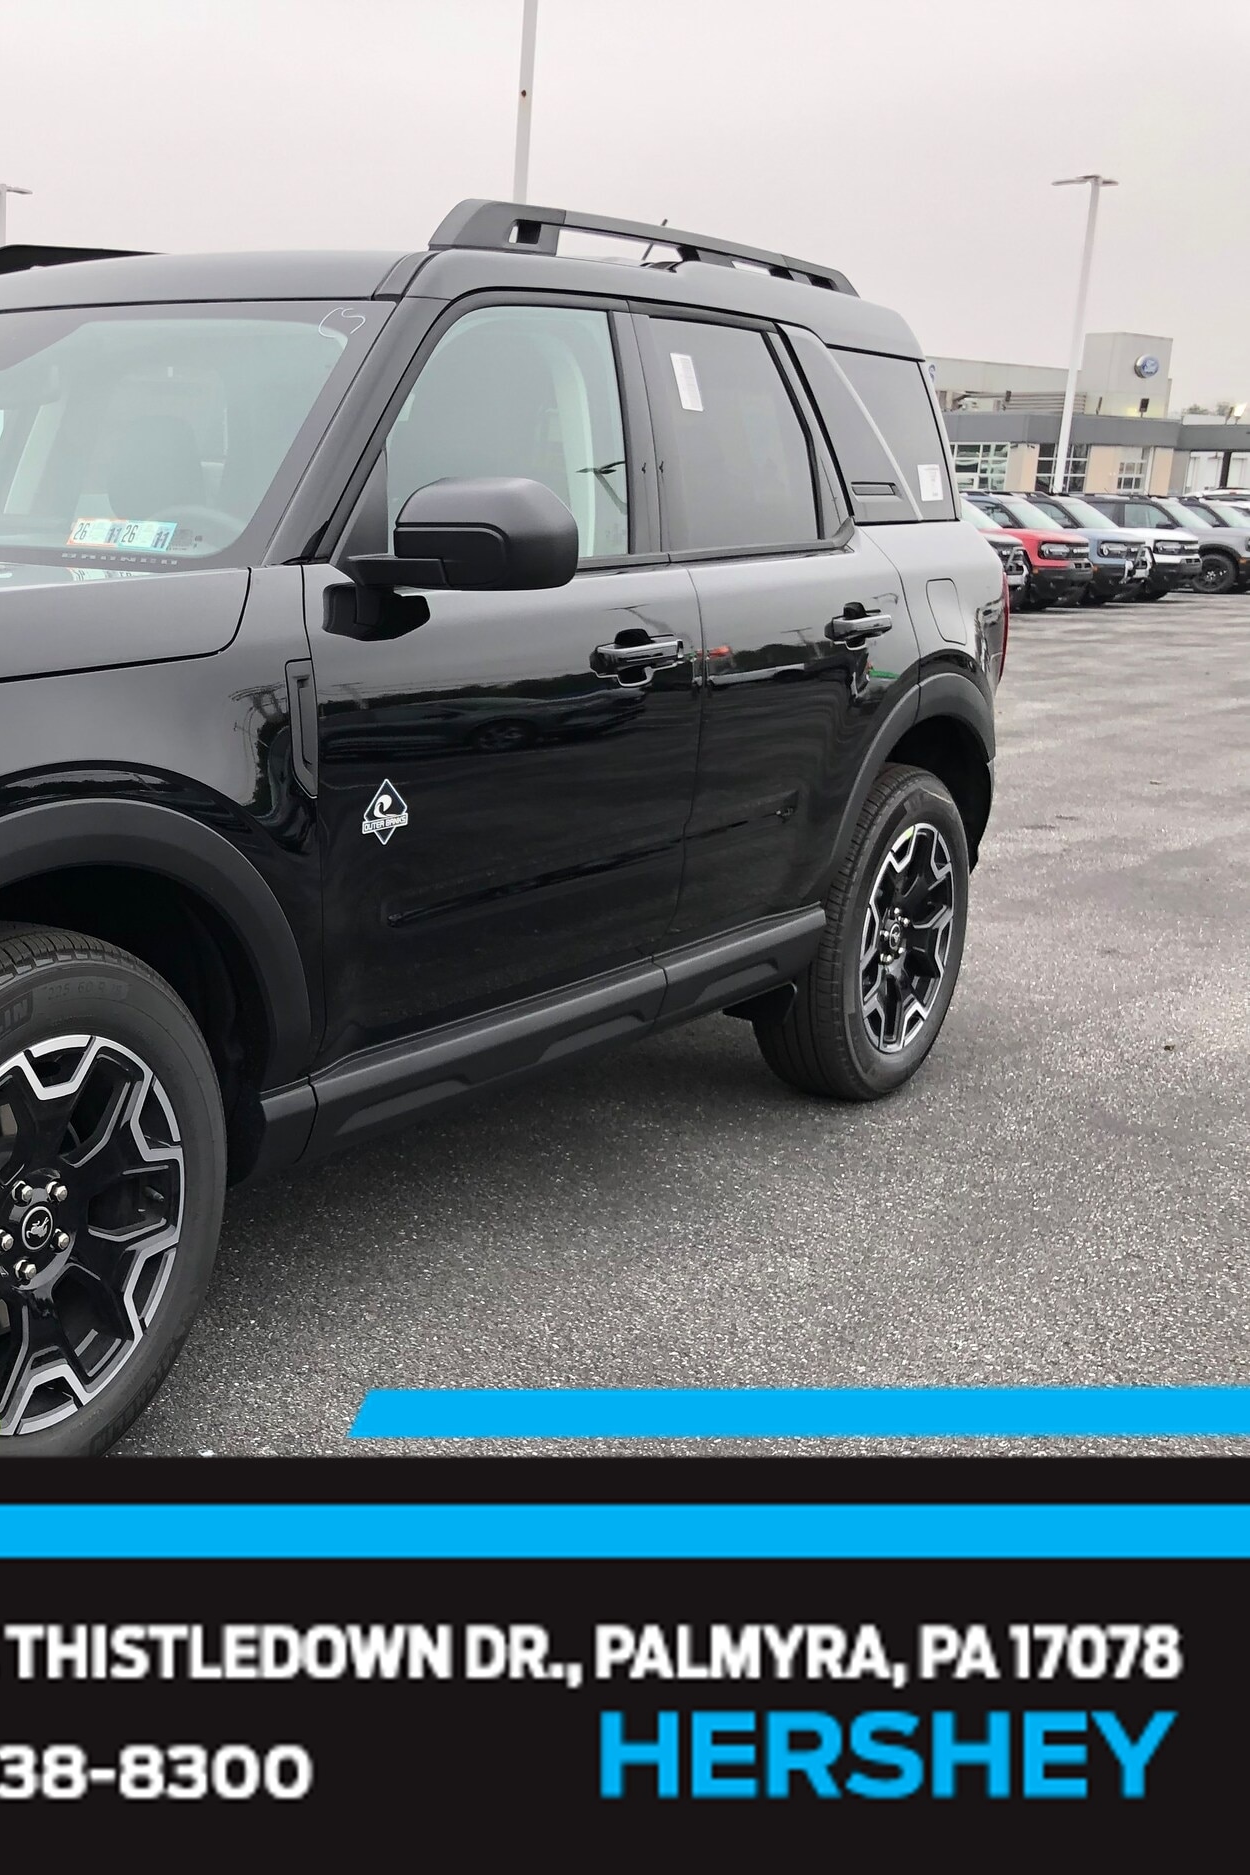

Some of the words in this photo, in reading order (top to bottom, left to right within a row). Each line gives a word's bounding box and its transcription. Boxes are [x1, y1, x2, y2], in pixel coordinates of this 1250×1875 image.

[73, 522, 91, 540] 26
[121, 524, 139, 543] 26
[364, 820, 385, 832] OUTER
[385, 815, 407, 827] BANKS
